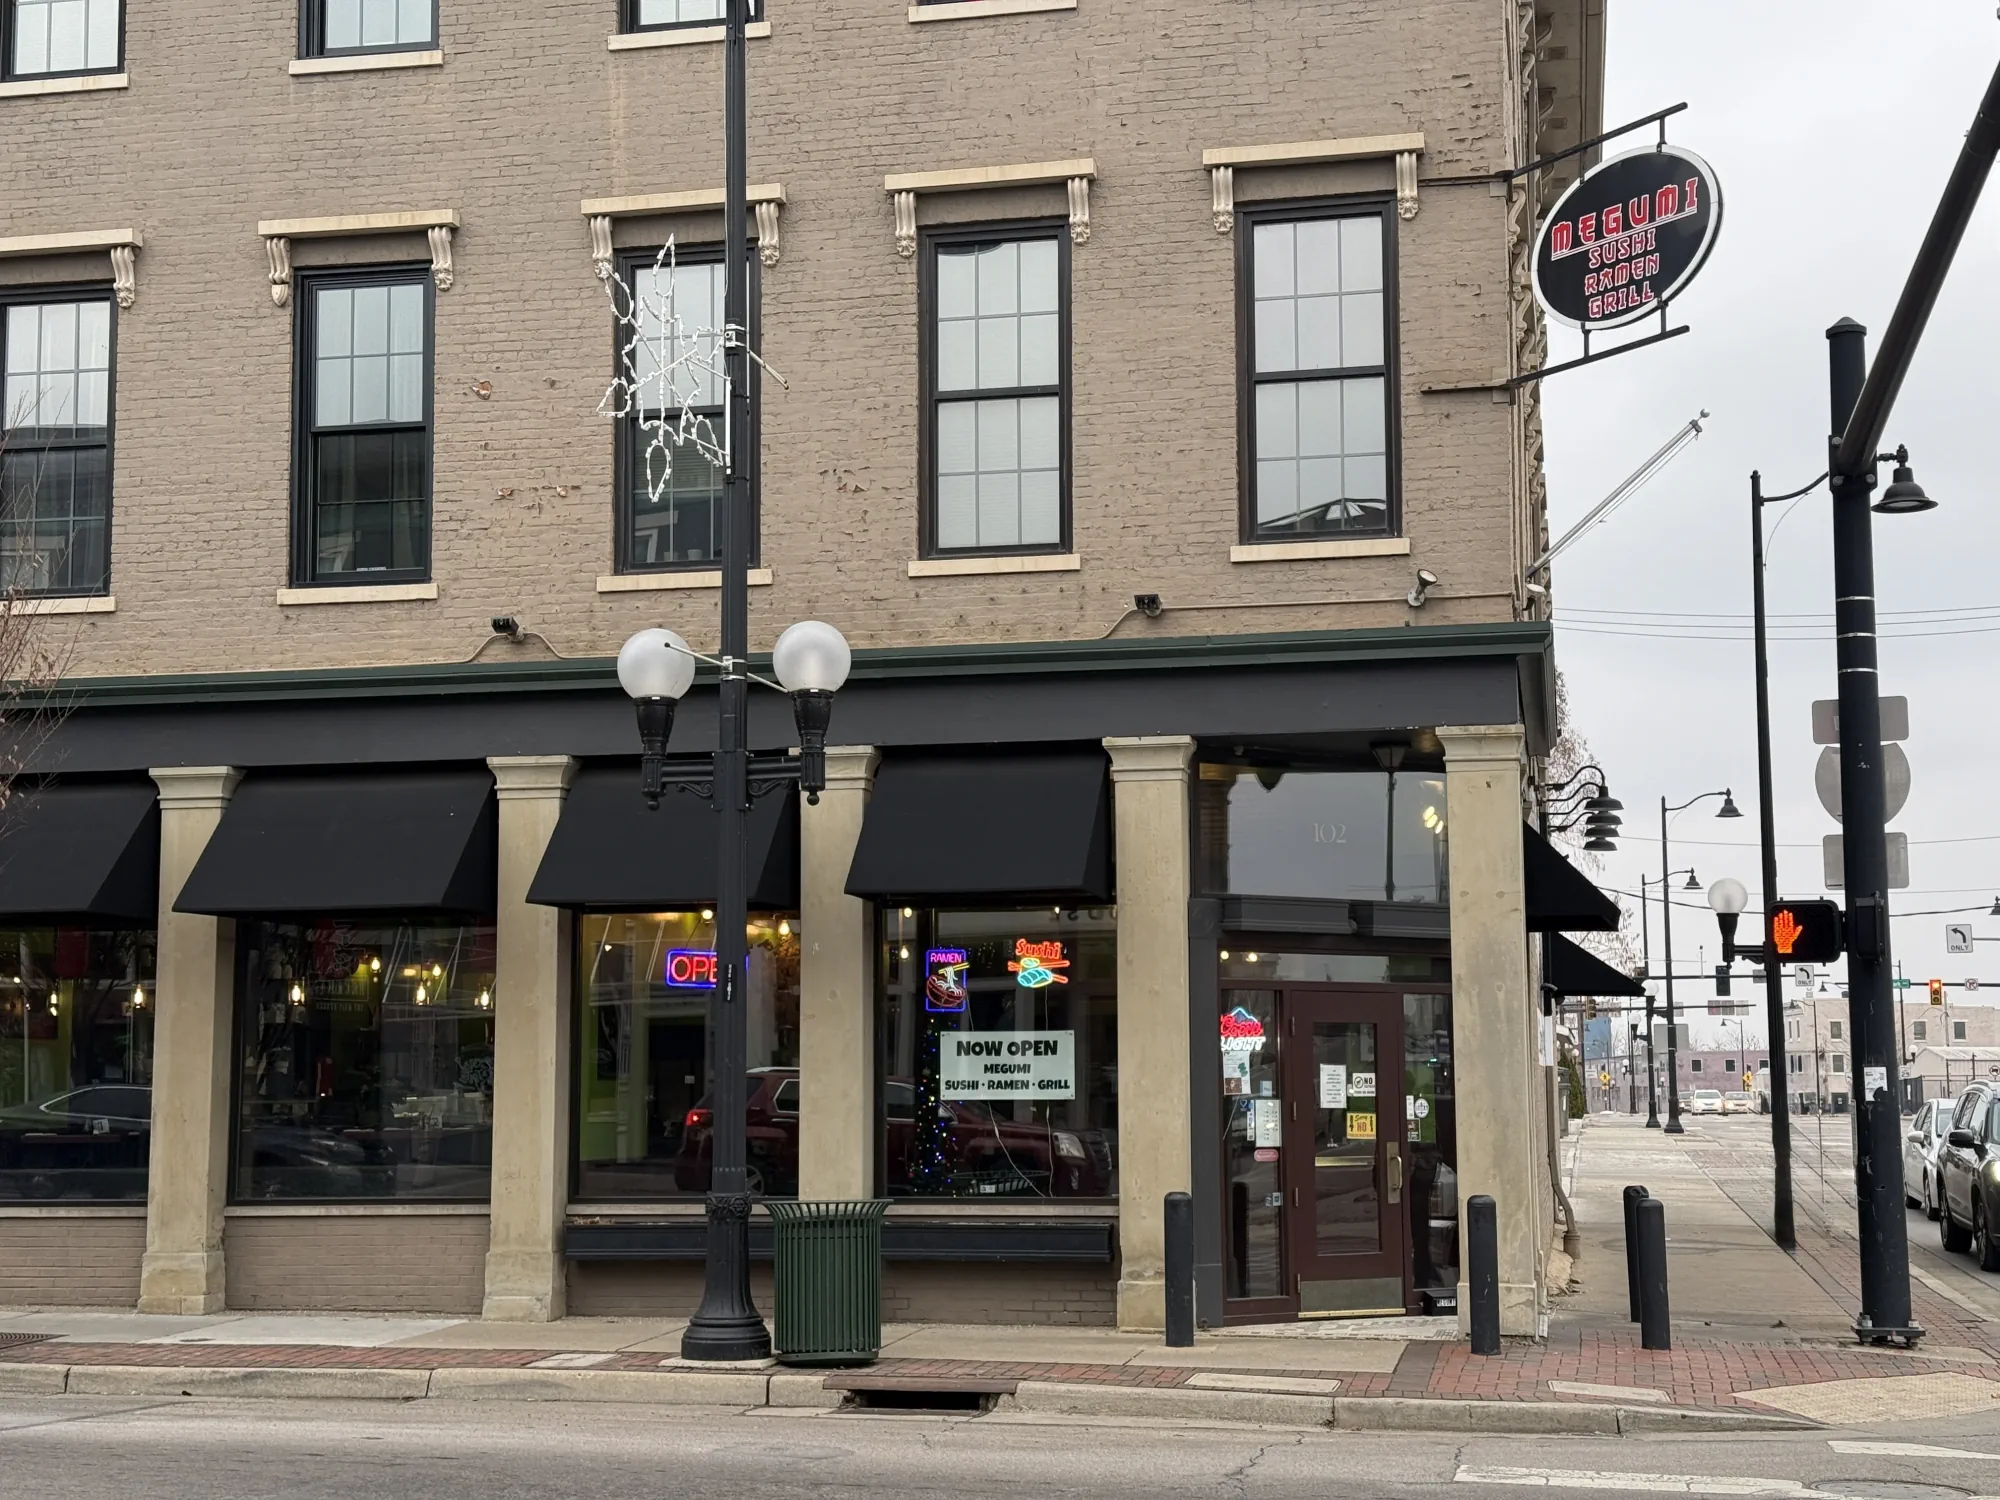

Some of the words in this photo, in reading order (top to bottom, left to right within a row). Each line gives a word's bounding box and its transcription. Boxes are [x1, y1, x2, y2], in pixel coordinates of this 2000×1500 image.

[1551, 177, 1698, 256] MEGUMI
[1589, 228, 1656, 268] SUSHI
[1584, 253, 1660, 295] RAMEN
[1588, 281, 1654, 318] GRILL
[1313, 823, 1347, 843] 102
[930, 952, 962, 963] RAMEN
[1015, 939, 1062, 960] Sushi
[671, 956, 717, 982] OPE
[956, 1041, 1003, 1056] NOW
[1007, 1040, 1058, 1056] OPEN
[984, 1064, 1031, 1074] MEGUMI
[945, 1080, 979, 1090] SUSHI
[988, 1080, 1029, 1090] RAMEN
[1038, 1080, 1070, 1089] GRILL
[1364, 1077, 1373, 1085] NO
